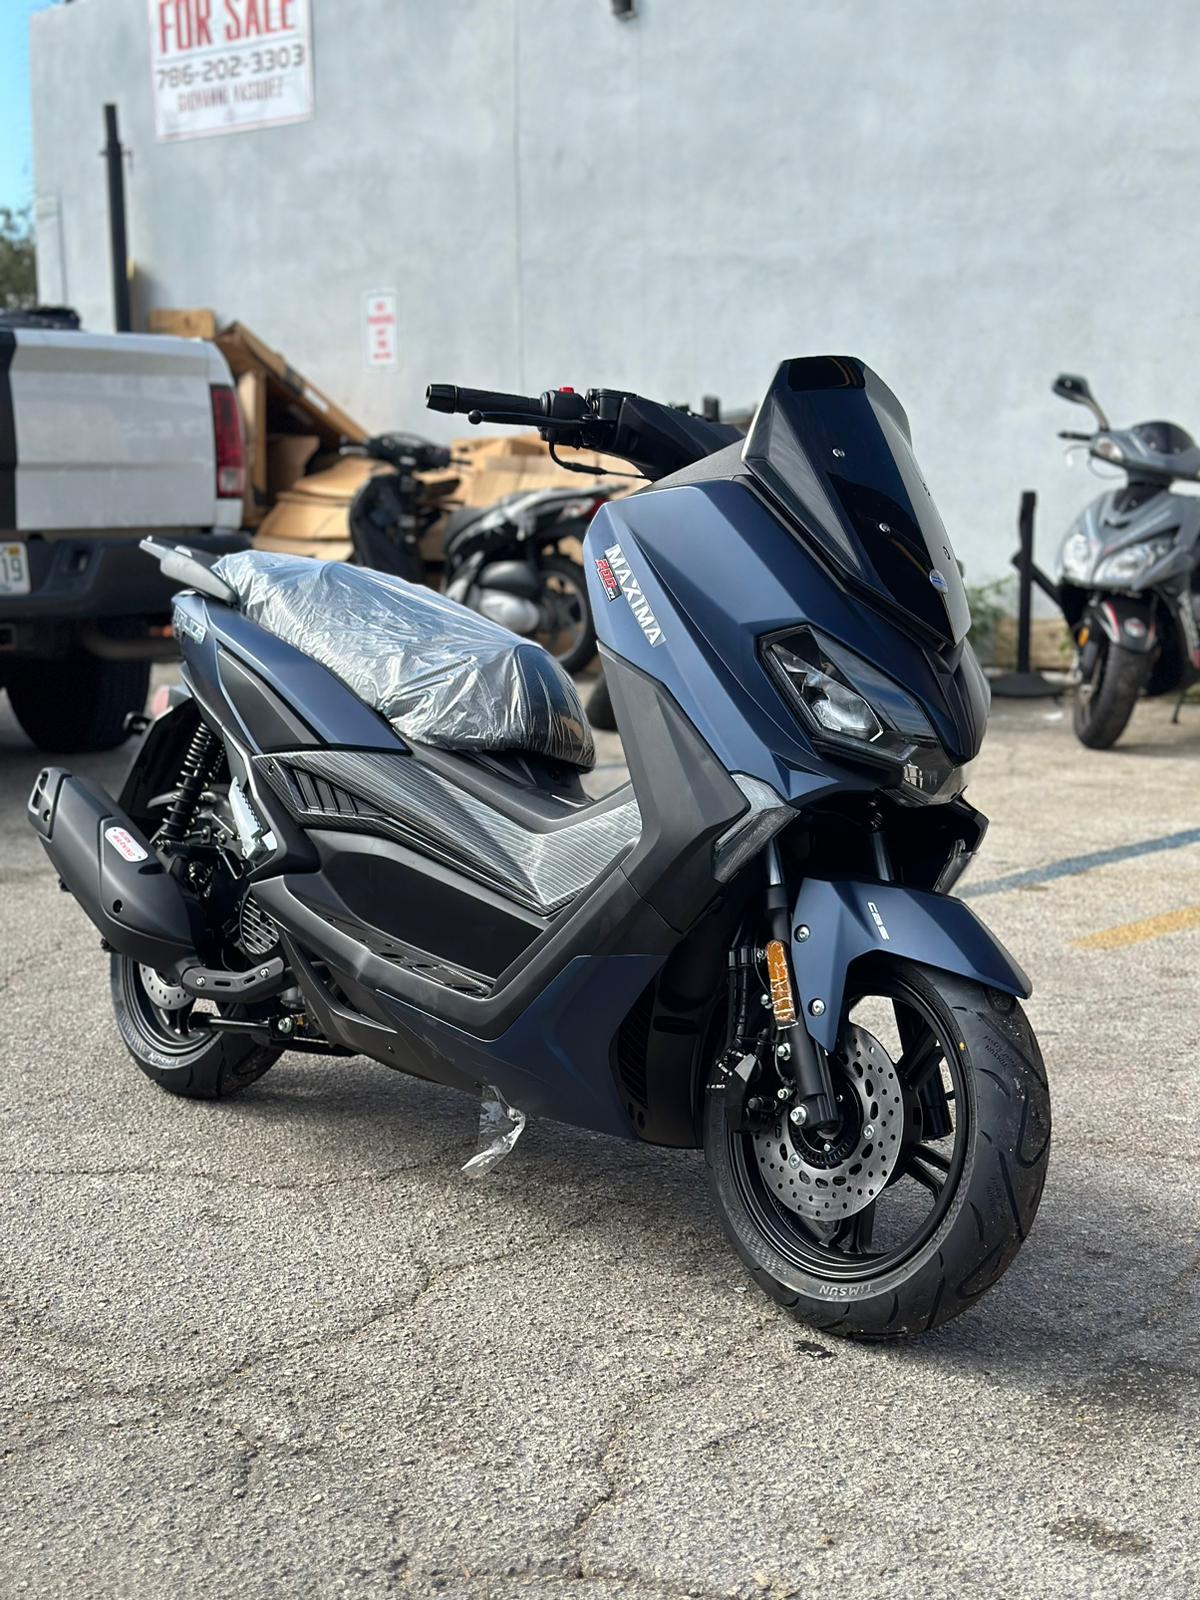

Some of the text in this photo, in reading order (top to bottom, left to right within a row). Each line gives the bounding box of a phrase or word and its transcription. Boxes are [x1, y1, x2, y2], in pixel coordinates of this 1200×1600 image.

[158, 0, 296, 54] FOR SALE
[156, 43, 305, 90] 786-202-3303
[604, 543, 663, 647] MAXIMA
[819, 1284, 873, 1297] TIMSUN
